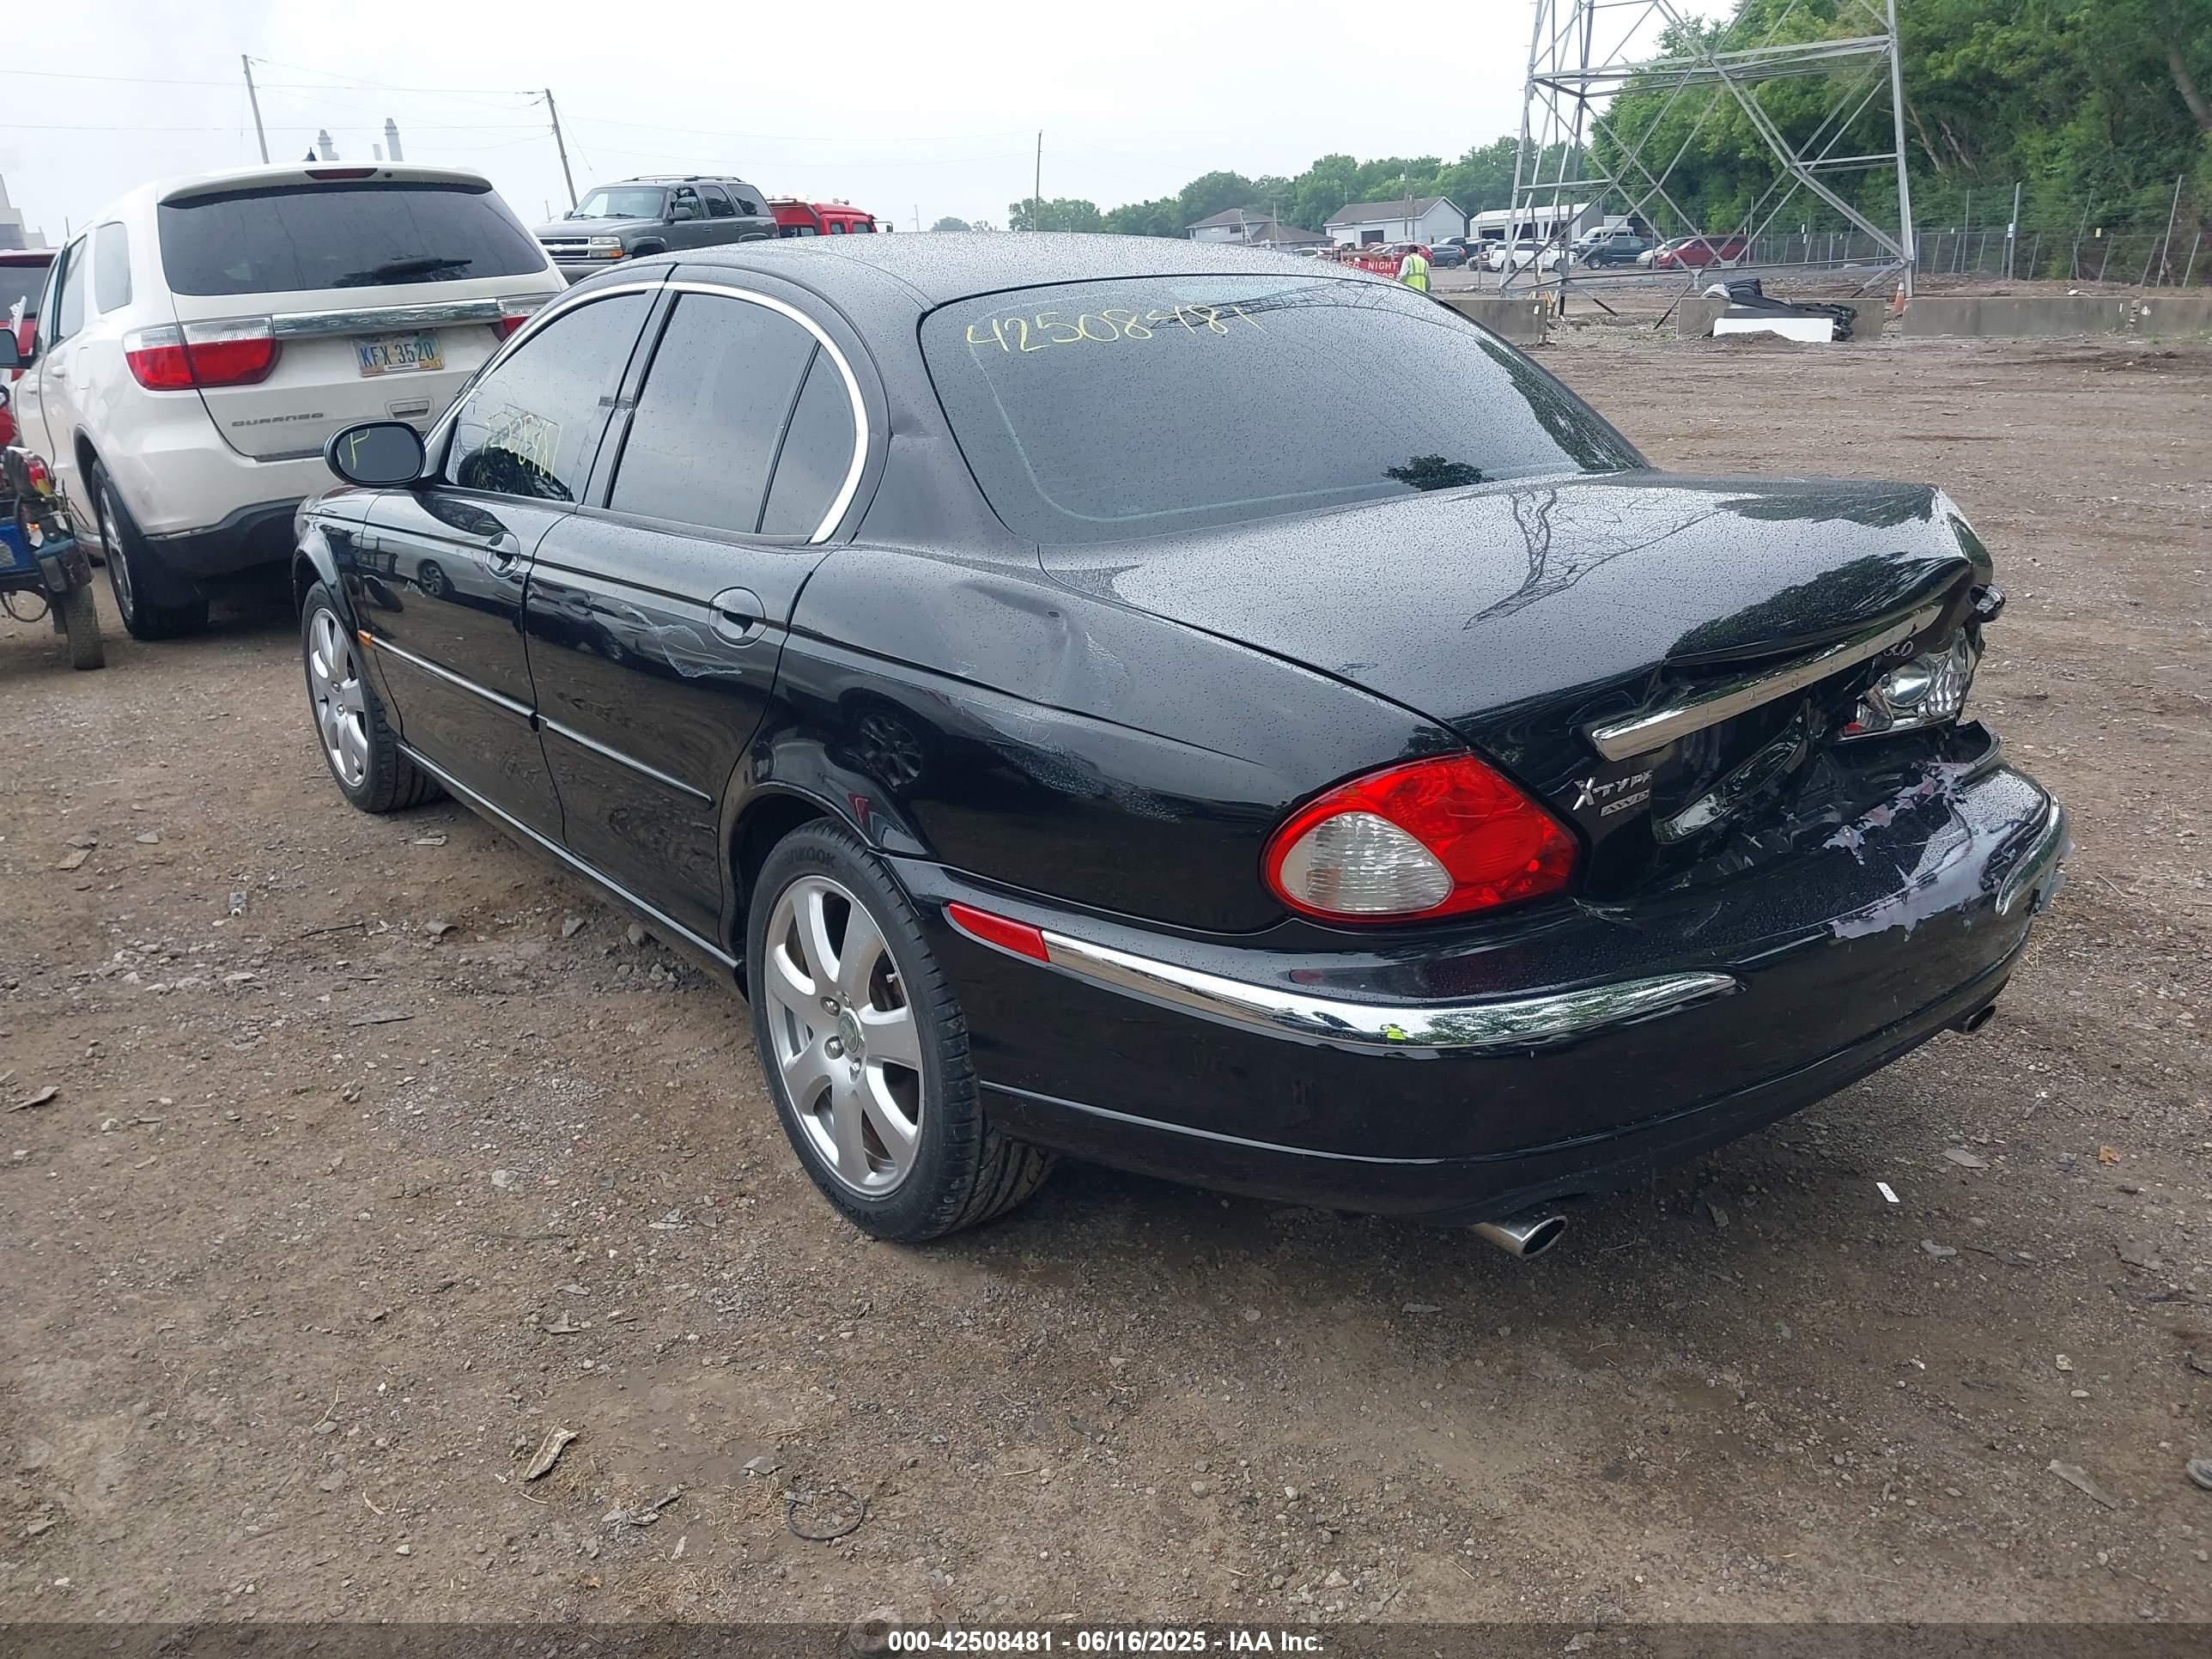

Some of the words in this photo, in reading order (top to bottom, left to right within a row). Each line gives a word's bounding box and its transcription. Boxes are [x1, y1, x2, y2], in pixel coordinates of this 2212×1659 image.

[1367, 261, 1398, 270] NIGHT
[965, 303, 1268, 353] 42508481
[361, 345, 392, 368] KFX
[395, 343, 434, 364] 3520
[231, 412, 324, 427] DURANGO
